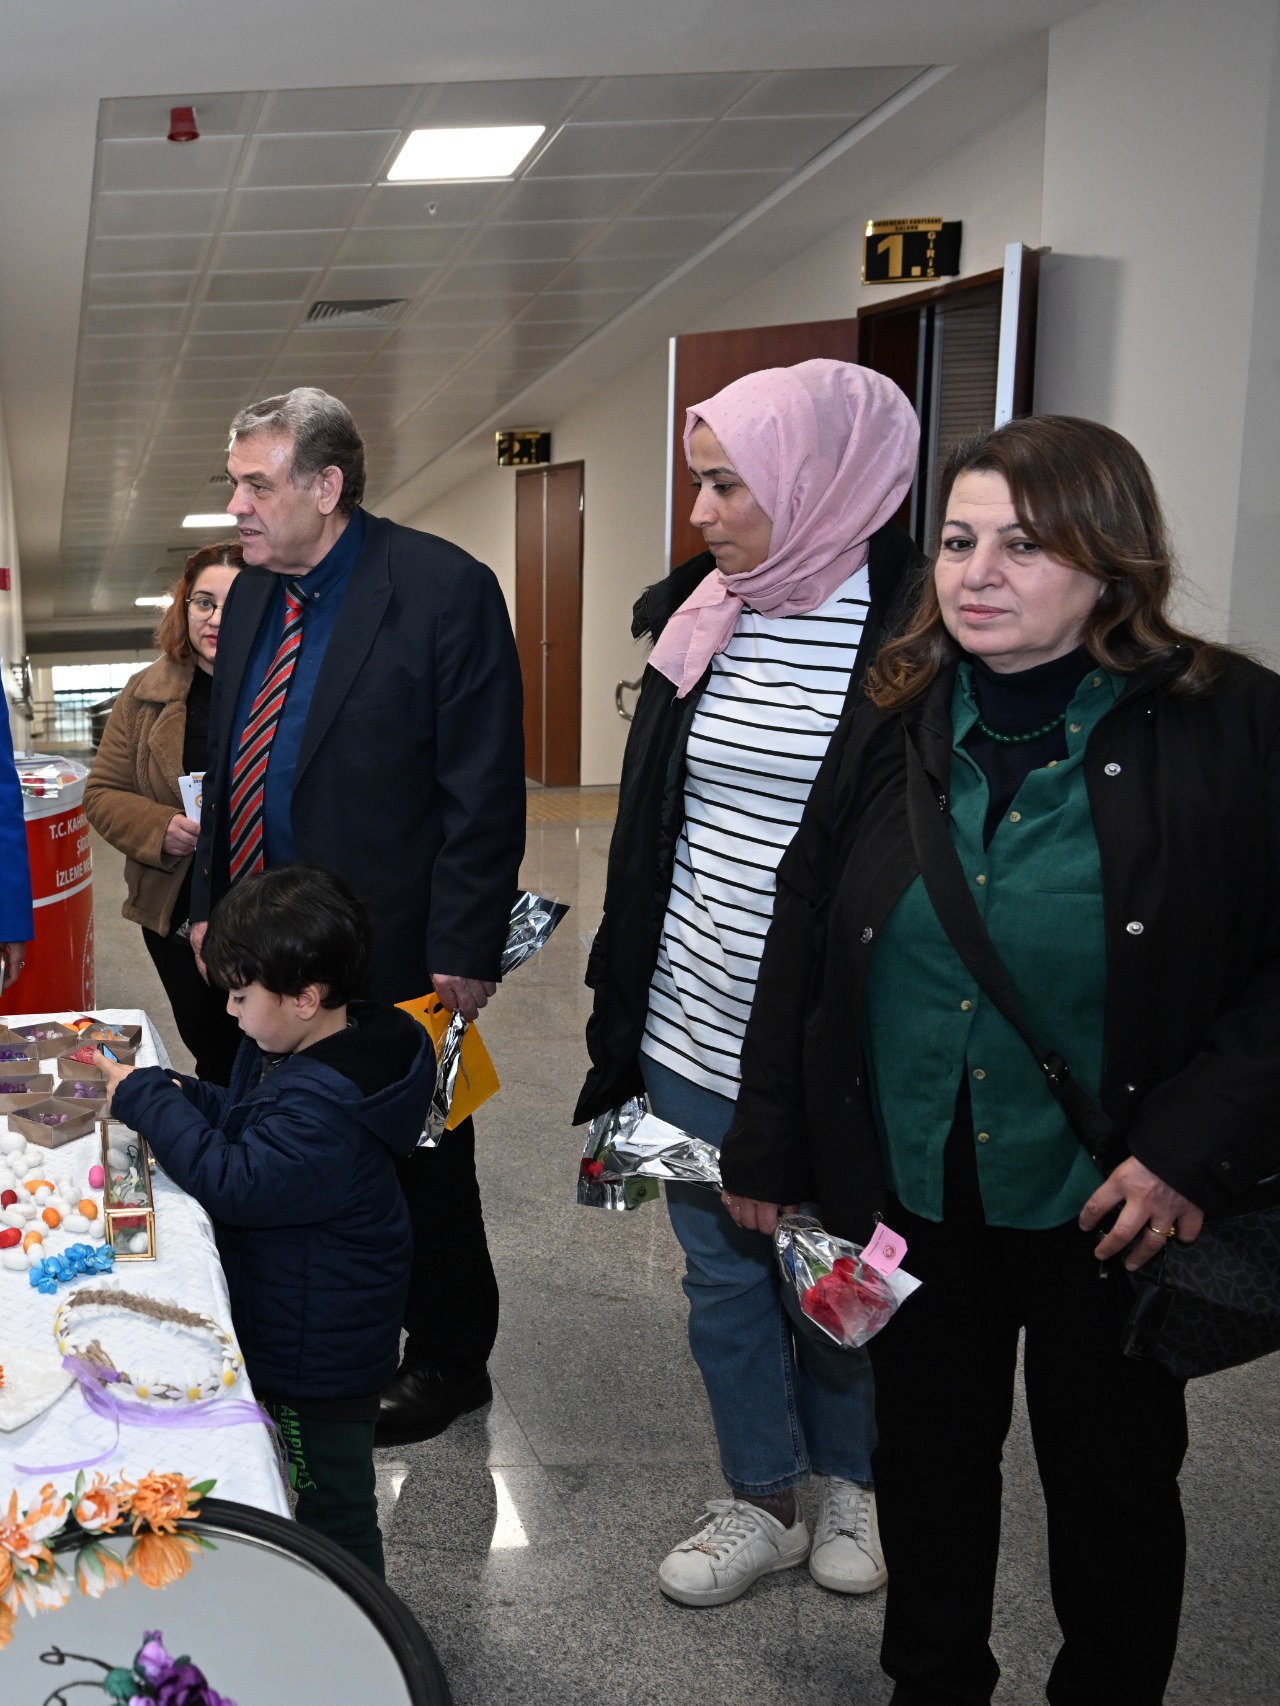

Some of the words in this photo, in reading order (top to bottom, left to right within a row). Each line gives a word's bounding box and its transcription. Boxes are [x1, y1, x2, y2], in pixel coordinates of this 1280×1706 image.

[877, 234, 922, 277] 1.
[49, 822, 67, 840] T.C.
[56, 863, 83, 888] İZLEME
